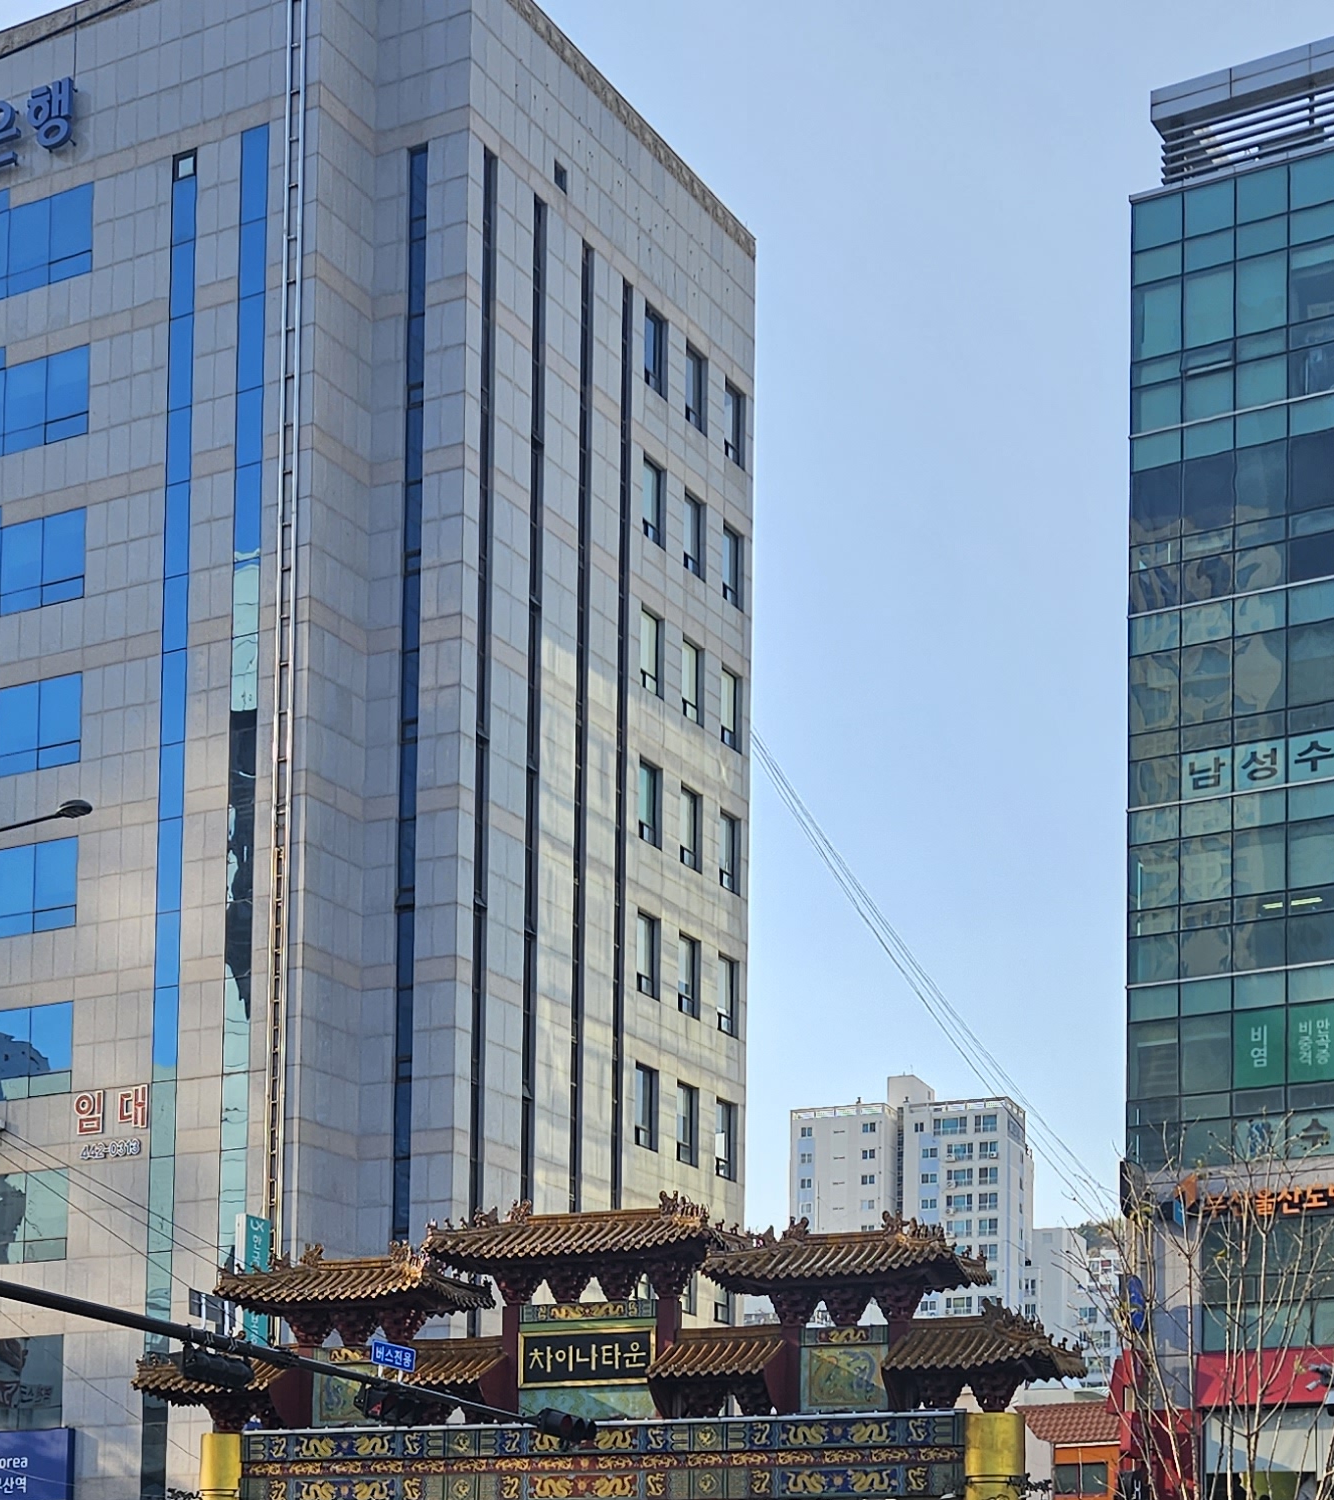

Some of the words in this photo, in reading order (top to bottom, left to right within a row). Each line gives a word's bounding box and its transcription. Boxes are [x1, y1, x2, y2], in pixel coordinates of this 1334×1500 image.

[1249, 1024, 1269, 1070] 비염
[72, 1083, 150, 1135] 임대
[79, 1138, 142, 1161] 442-0313
[375, 1344, 413, 1369] 버스전용
[528, 1341, 647, 1374] 차이나타운
